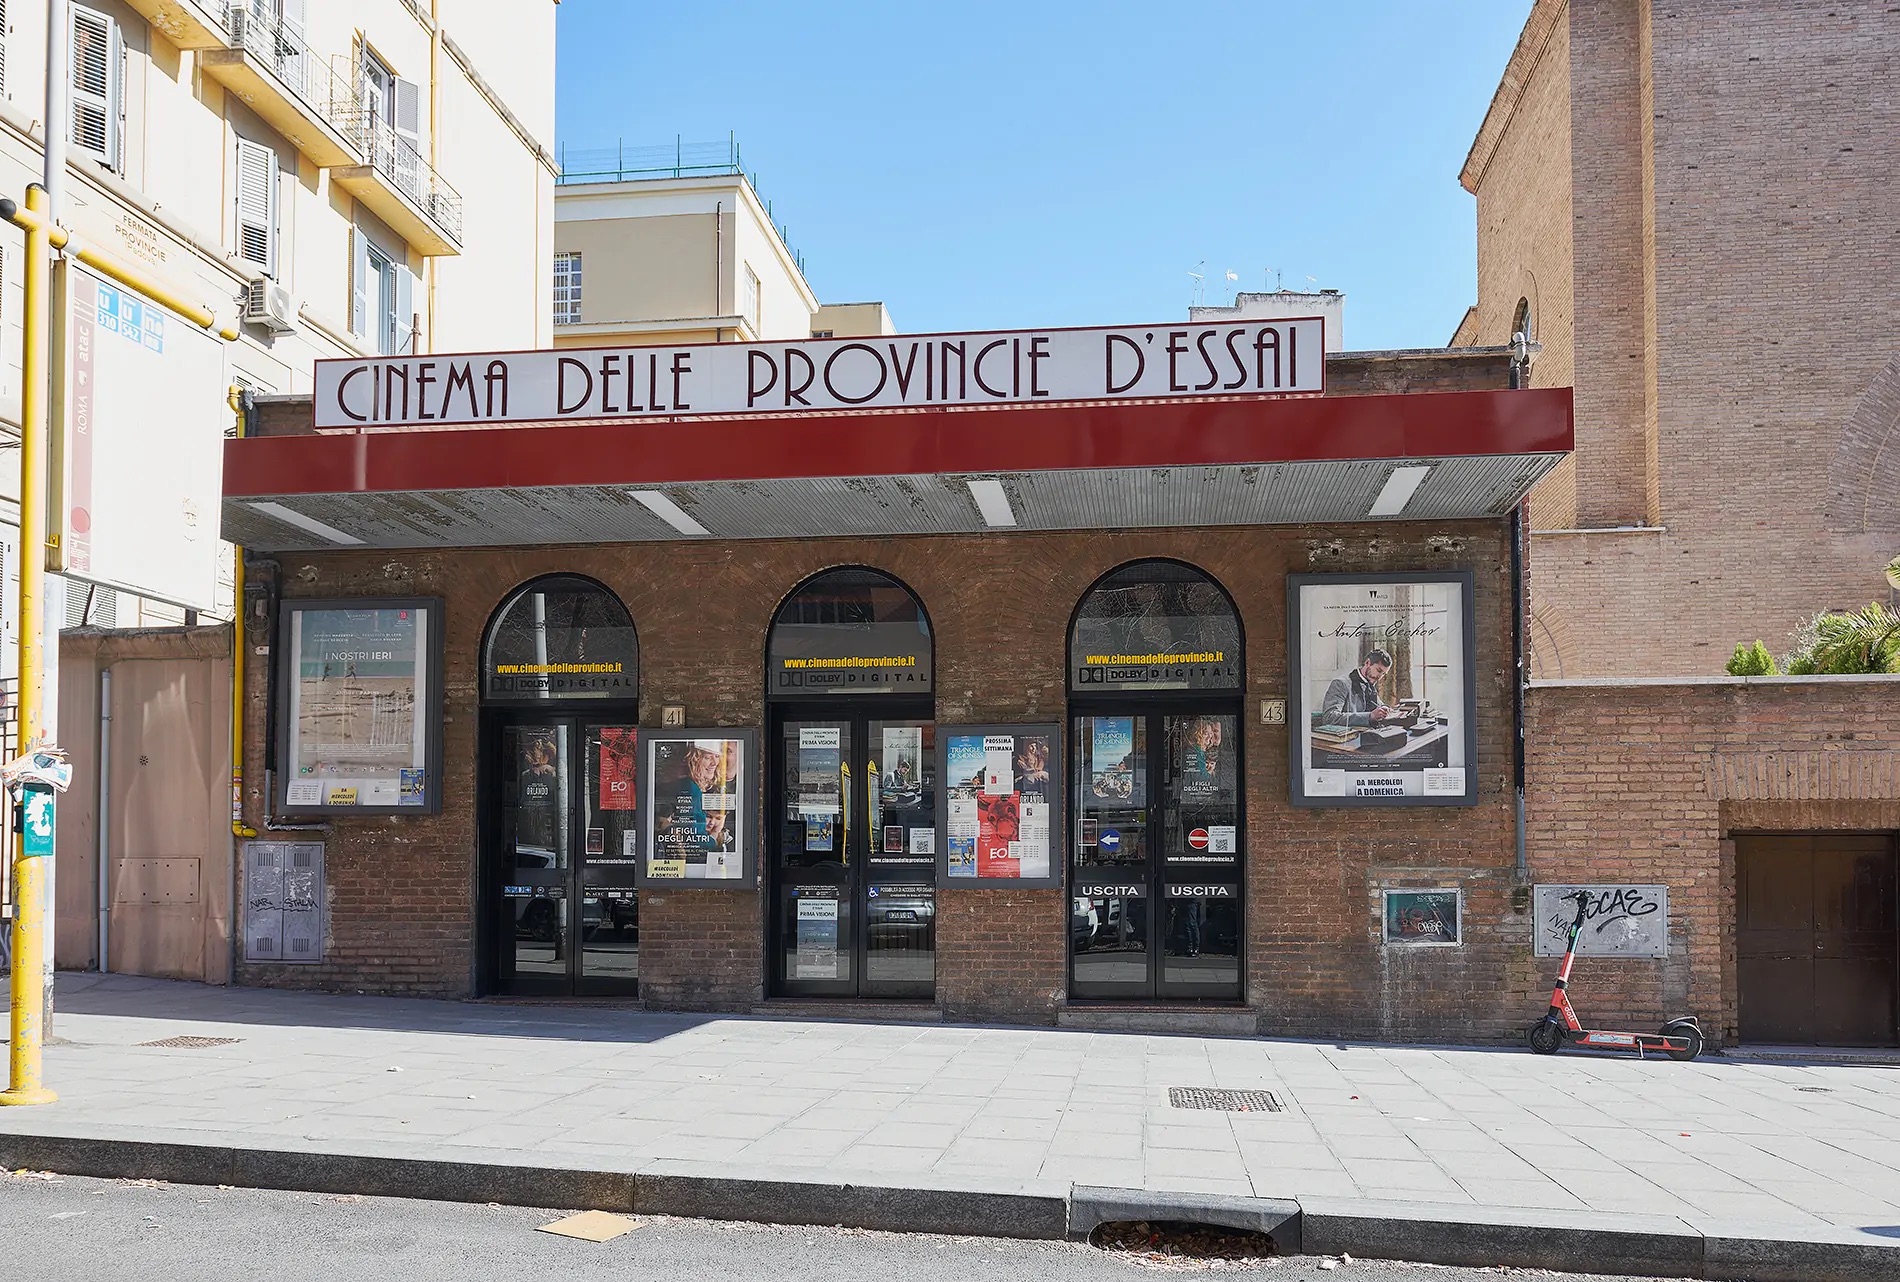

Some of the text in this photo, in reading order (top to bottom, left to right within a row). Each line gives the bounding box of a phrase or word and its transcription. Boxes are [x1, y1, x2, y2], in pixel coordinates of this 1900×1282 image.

[123, 215, 157, 242] FERMATA
[115, 224, 166, 262] PROVINCIE
[98, 311, 117, 330] 310
[122, 323, 139, 342] 542
[79, 325, 89, 362] atac
[337, 326, 1297, 421] CINEMA DELLE PROVINCIE D'ESSAI
[77, 395, 88, 435] ROMA
[331, 651, 369, 660] NOSTRI
[371, 651, 392, 660] IERI
[784, 655, 916, 668] www.cinemadelleprovincie.it
[1086, 651, 1224, 665] www.cinemadelleprovincie.it
[497, 662, 622, 674] www.cinemadelleprovincie.it
[1111, 668, 1235, 679] DOLBY DIGITAL
[520, 678, 631, 688] DOLBY DIGITAL
[809, 673, 928, 683] DOLBY DIGITAL
[666, 710, 681, 724] 41
[1263, 705, 1283, 721] 43
[610, 781, 627, 792] EO
[1357, 787, 1404, 796] A DOMENICA
[676, 827, 697, 835] FIGLI
[990, 847, 1007, 859] EO
[1082, 886, 1139, 896] USCITA
[1171, 886, 1229, 896] USCITA
[1564, 1006, 1575, 1022] dott
